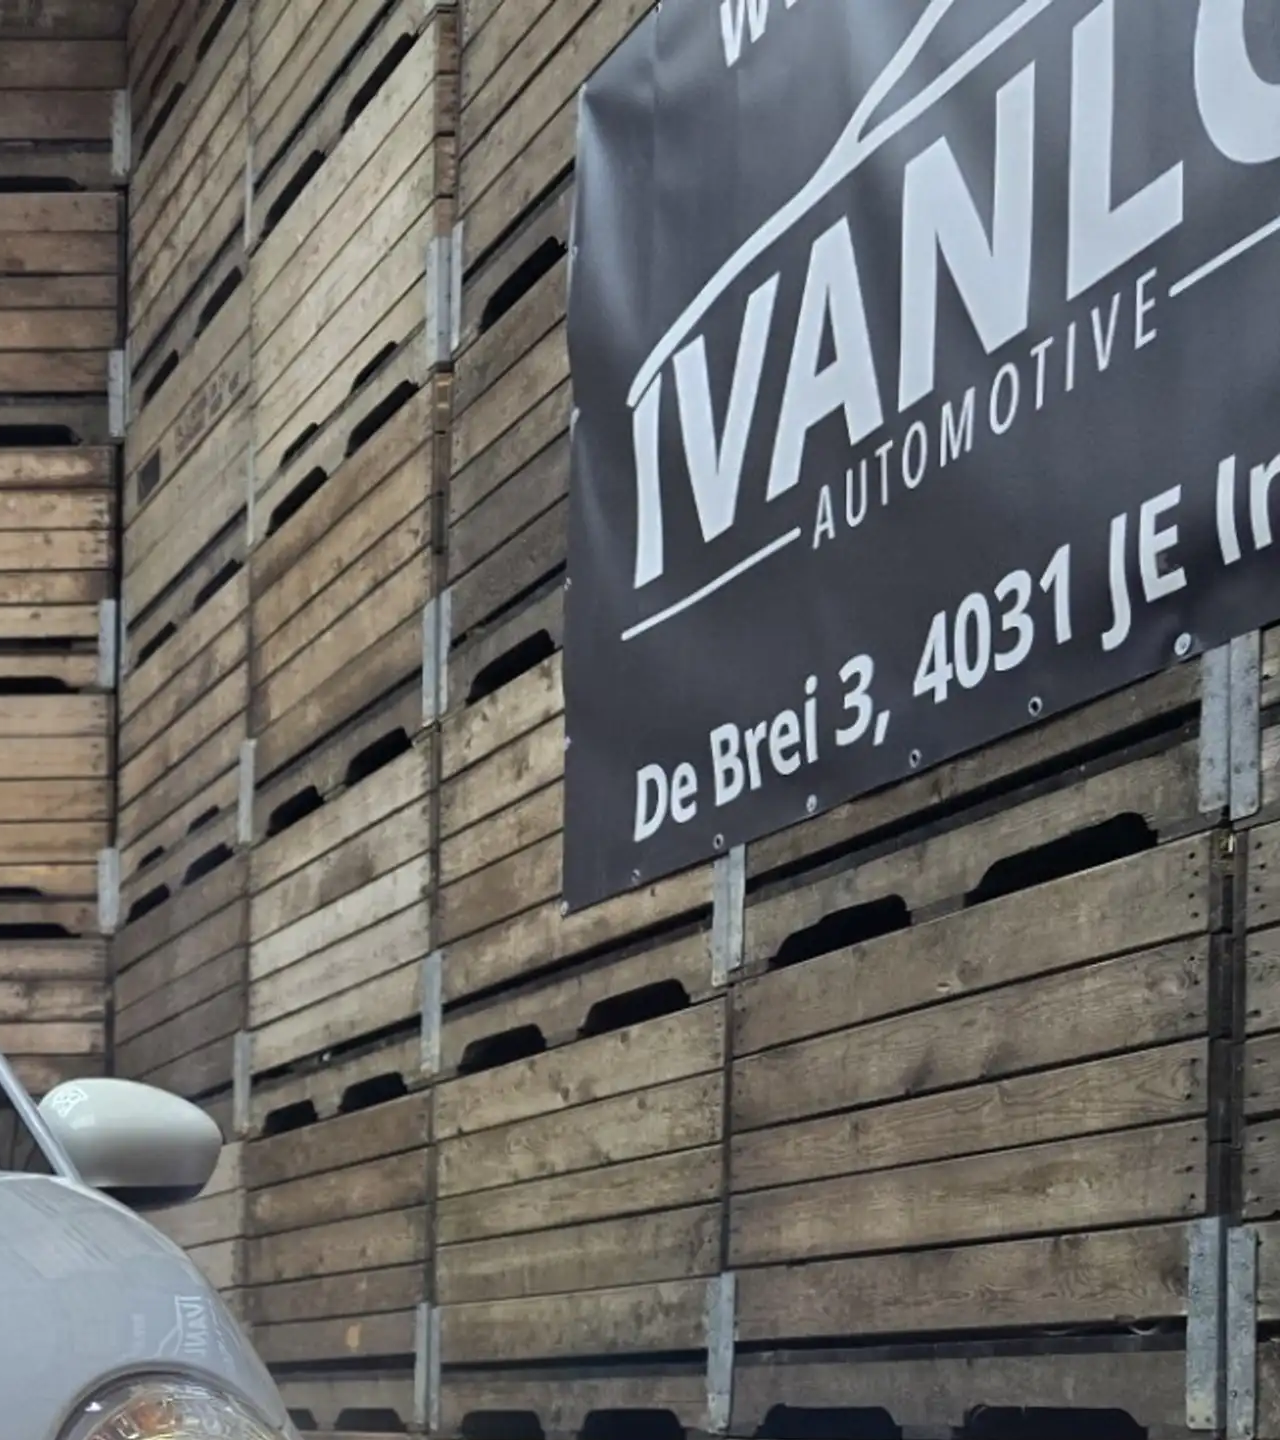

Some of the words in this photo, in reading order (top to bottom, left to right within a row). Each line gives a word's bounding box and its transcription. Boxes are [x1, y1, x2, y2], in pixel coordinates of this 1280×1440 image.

[813, 267, 1157, 550] AUTOMOTIVE
[634, 763, 698, 843] De
[710, 674, 818, 807] Brei
[835, 653, 890, 746] 3,
[913, 543, 1072, 705] 4031
[1101, 484, 1188, 652] JE
